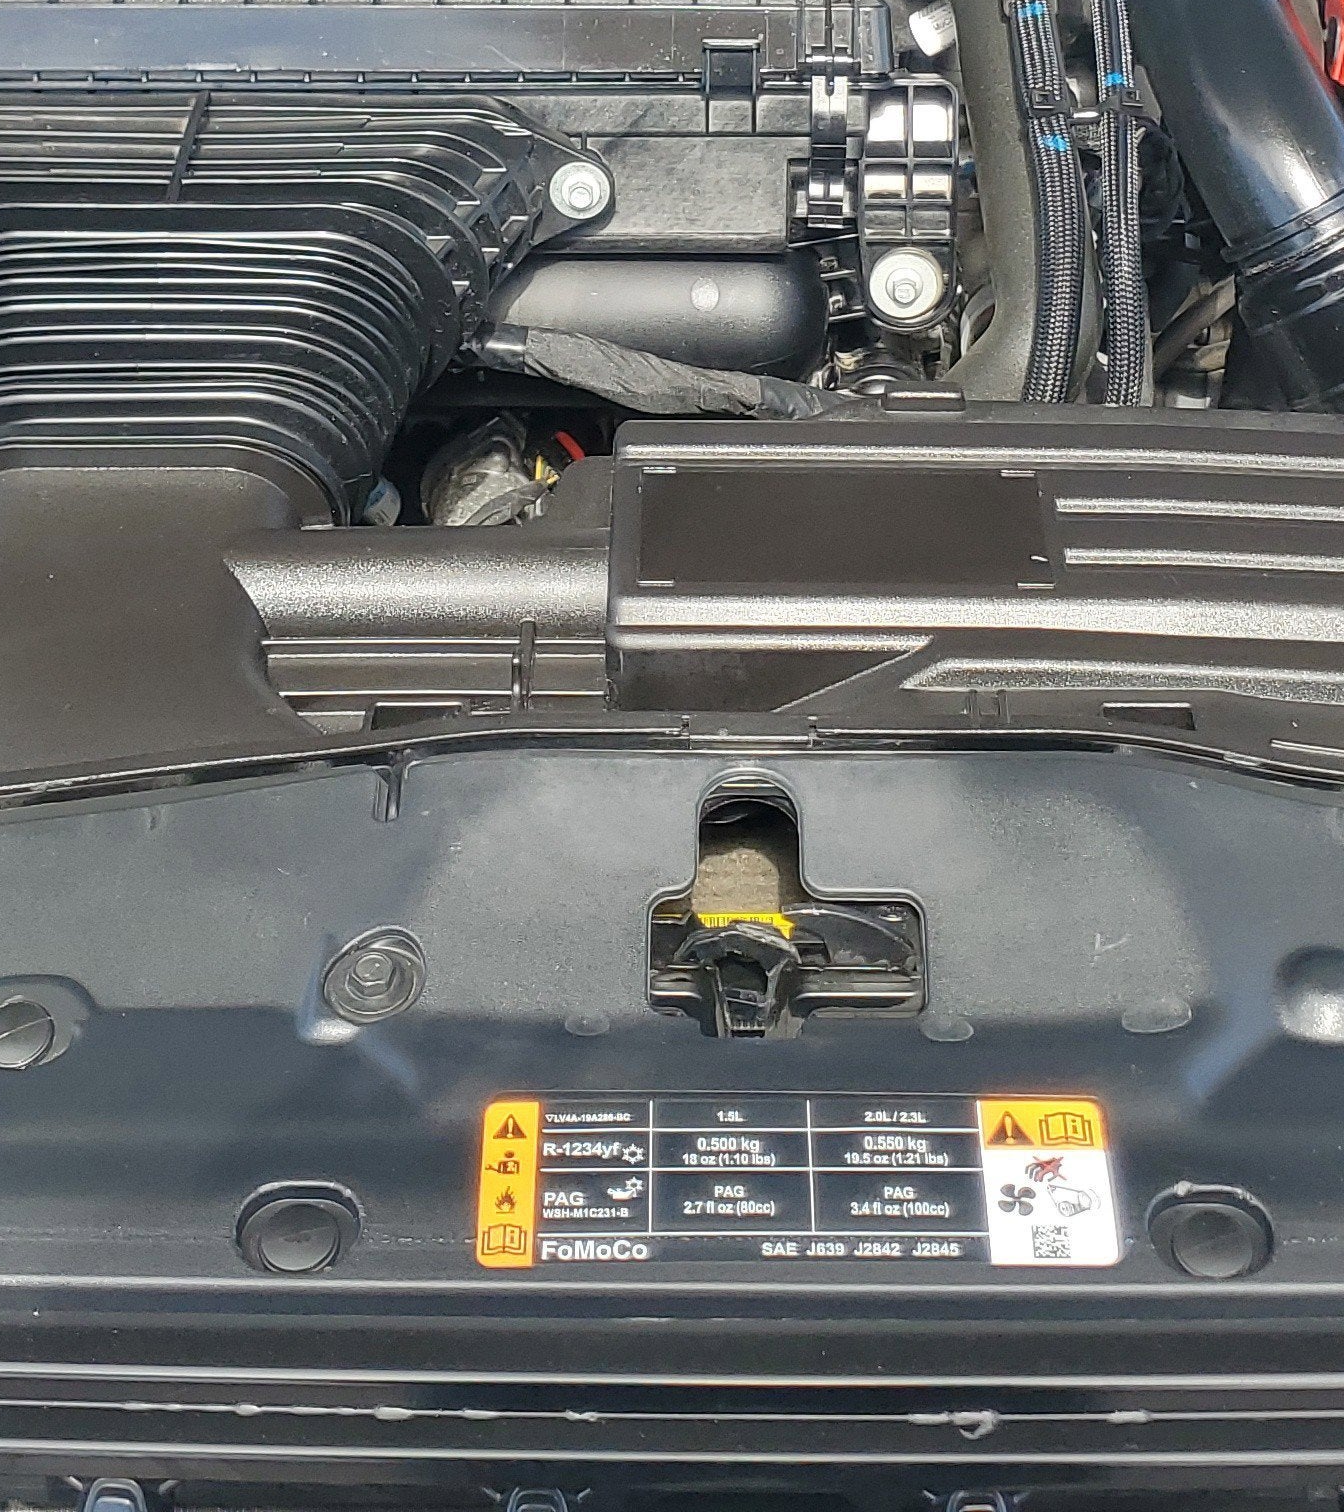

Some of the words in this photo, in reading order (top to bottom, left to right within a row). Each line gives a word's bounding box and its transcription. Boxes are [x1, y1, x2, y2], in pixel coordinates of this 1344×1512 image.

[716, 1109, 744, 1123] 1.5L
[864, 1110, 892, 1123] 2.0L
[899, 1111, 927, 1124] 2.3L
[542, 1142, 622, 1159] R-1234yf
[697, 1137, 738, 1152] 0.500
[741, 1137, 760, 1154] kg
[864, 1135, 904, 1150] 0.550
[907, 1135, 927, 1153] kg
[682, 1153, 697, 1166] 18
[700, 1155, 716, 1165] oz
[751, 1152, 776, 1167] lbs)
[873, 1154, 890, 1165] oz
[924, 1151, 949, 1167] lbs)
[543, 1191, 585, 1207] PAG
[714, 1185, 746, 1198] PAG
[883, 1186, 915, 1199] PAG
[683, 1200, 703, 1215] 2.7
[706, 1200, 715, 1214] fl
[717, 1203, 734, 1215] oz
[736, 1200, 775, 1217] (80cc)
[850, 1201, 870, 1216] 3.4
[872, 1200, 882, 1215] fl
[884, 1204, 901, 1216] oz
[540, 1239, 648, 1261] FoMoCo
[761, 1241, 798, 1256] SAE
[806, 1241, 845, 1257] J639
[853, 1241, 902, 1257] J2842
[911, 1241, 961, 1257] J2845
